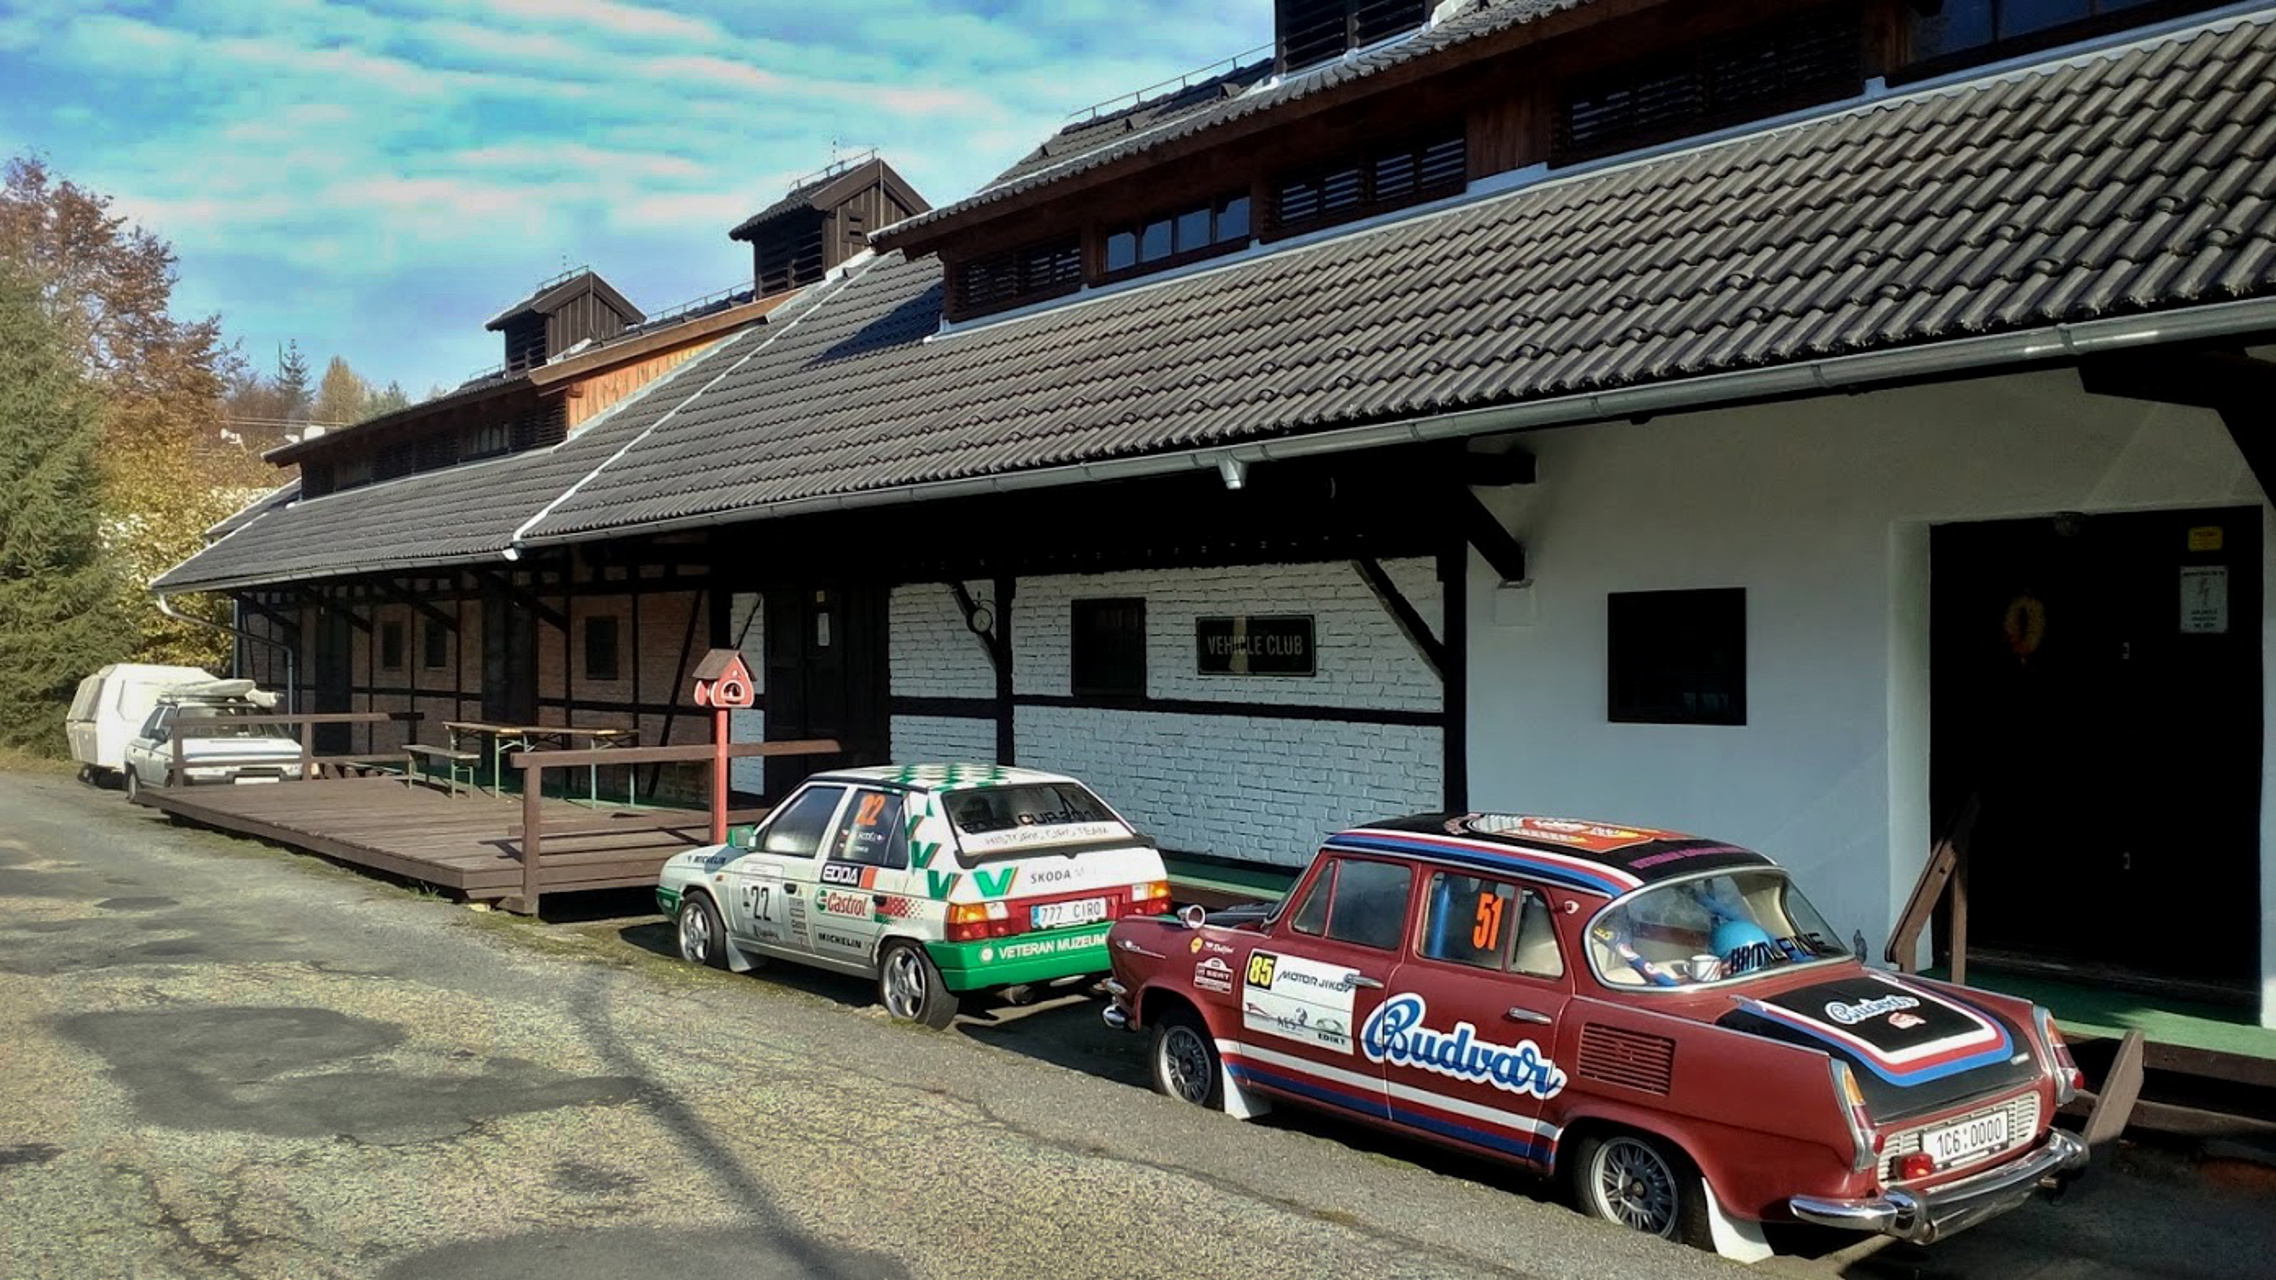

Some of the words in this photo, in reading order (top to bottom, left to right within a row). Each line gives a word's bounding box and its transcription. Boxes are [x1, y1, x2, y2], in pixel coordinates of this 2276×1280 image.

[1207, 634, 1262, 655] VEHICLE
[1266, 634, 1303, 655] CLUB
[854, 792, 886, 826] 22
[823, 866, 859, 884] EDDA
[1031, 870, 1071, 884] SKODA
[751, 885, 771, 921] 22
[827, 892, 867, 917] Castrol
[1041, 906, 1062, 922] 777
[1473, 892, 1503, 950] 51
[818, 932, 862, 949] MICHELIN
[999, 941, 1054, 960] VETERAN
[1057, 933, 1108, 953] MUZEUM
[1248, 955, 1274, 987] 85
[1276, 970, 1318, 987] MOTOR
[1363, 997, 1561, 1094] Budvar
